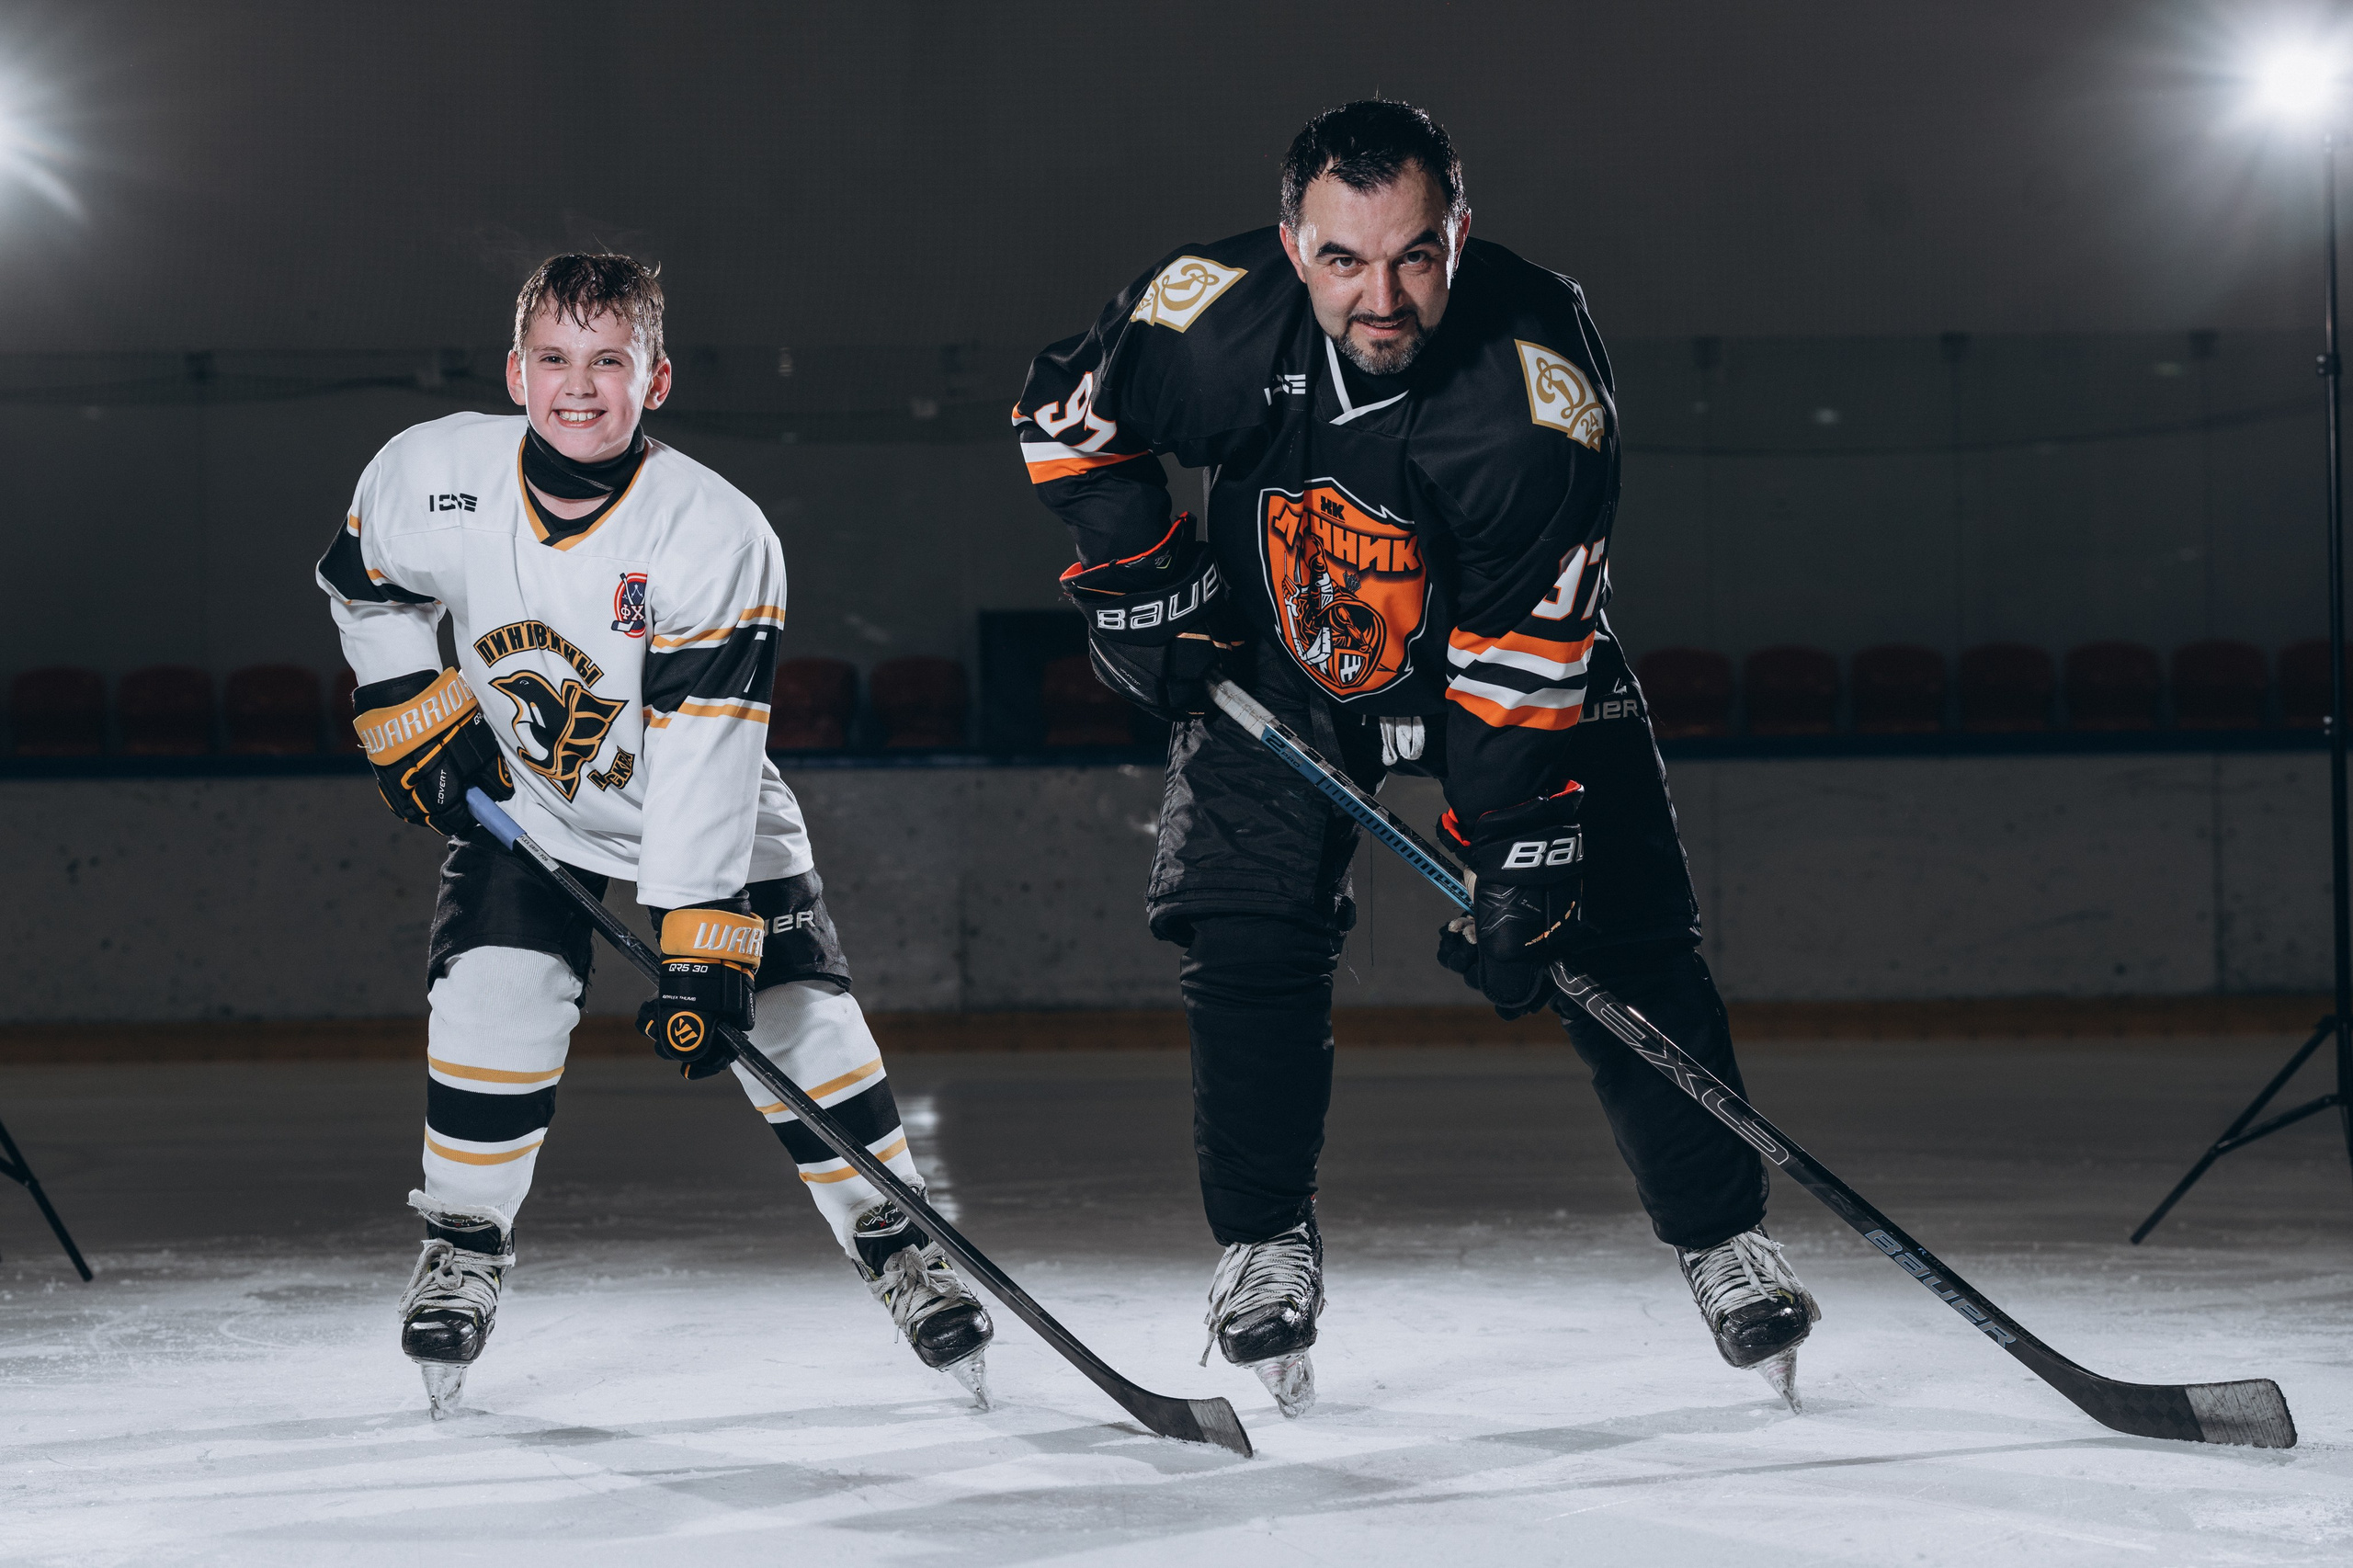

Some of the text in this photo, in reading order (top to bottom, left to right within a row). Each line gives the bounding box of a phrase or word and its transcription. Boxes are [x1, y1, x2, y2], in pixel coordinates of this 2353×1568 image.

[1581, 411, 1598, 437] 24
[438, 769, 449, 805] COVERT
[692, 965, 708, 973] 30
